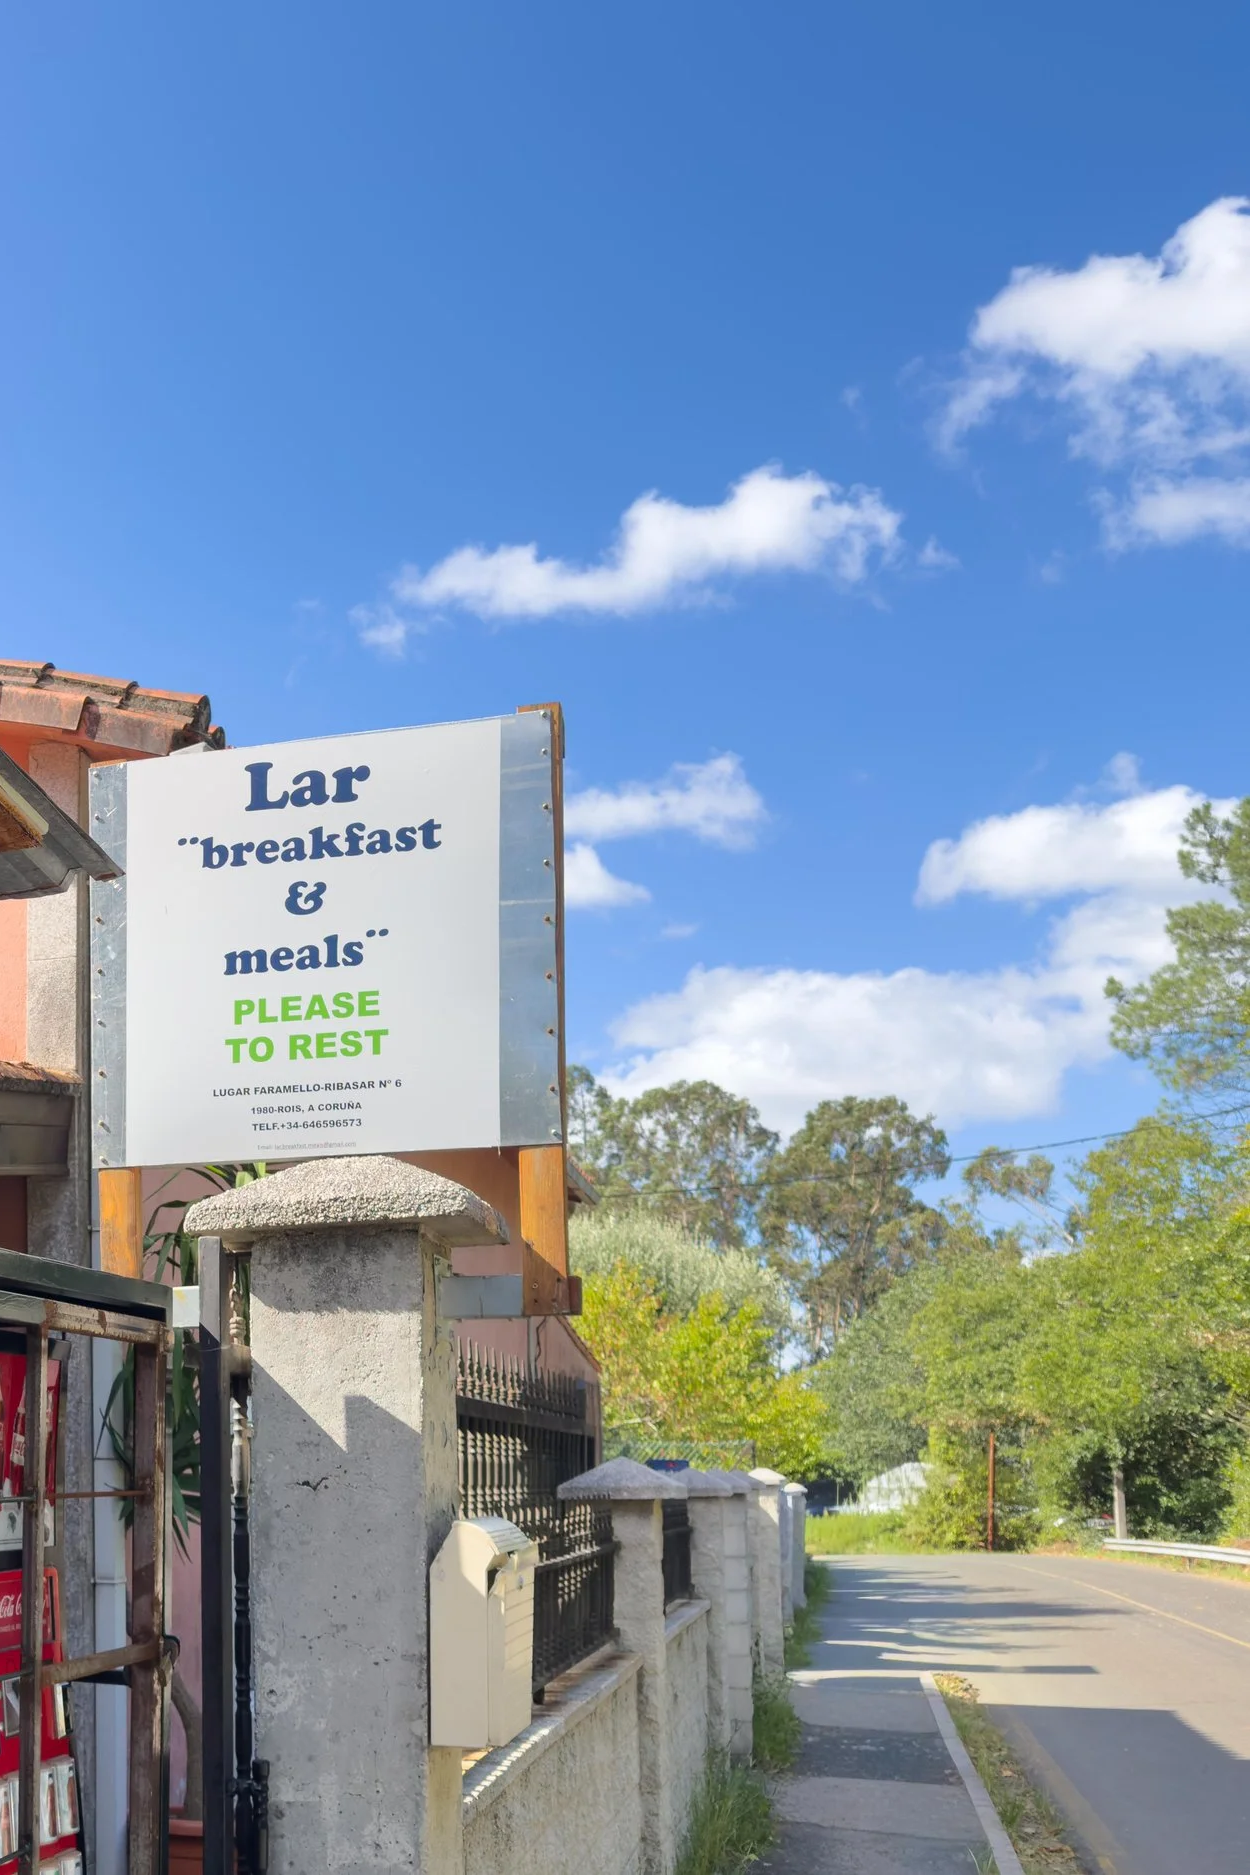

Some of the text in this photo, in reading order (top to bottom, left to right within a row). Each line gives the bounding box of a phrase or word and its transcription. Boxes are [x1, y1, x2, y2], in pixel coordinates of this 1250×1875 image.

[245, 761, 371, 812] Lar
[284, 880, 328, 916] &
[233, 990, 381, 1026] PLEASE
[224, 1028, 390, 1064] TO REST
[212, 1087, 251, 1098] LUGAR
[253, 1080, 376, 1096] FARAMELLO-RIBASAR
[394, 1078, 402, 1088] 6
[250, 1100, 362, 1115] 1980-ROIS, A CORUÑA
[251, 1118, 362, 1132] TELF.+34-646596573
